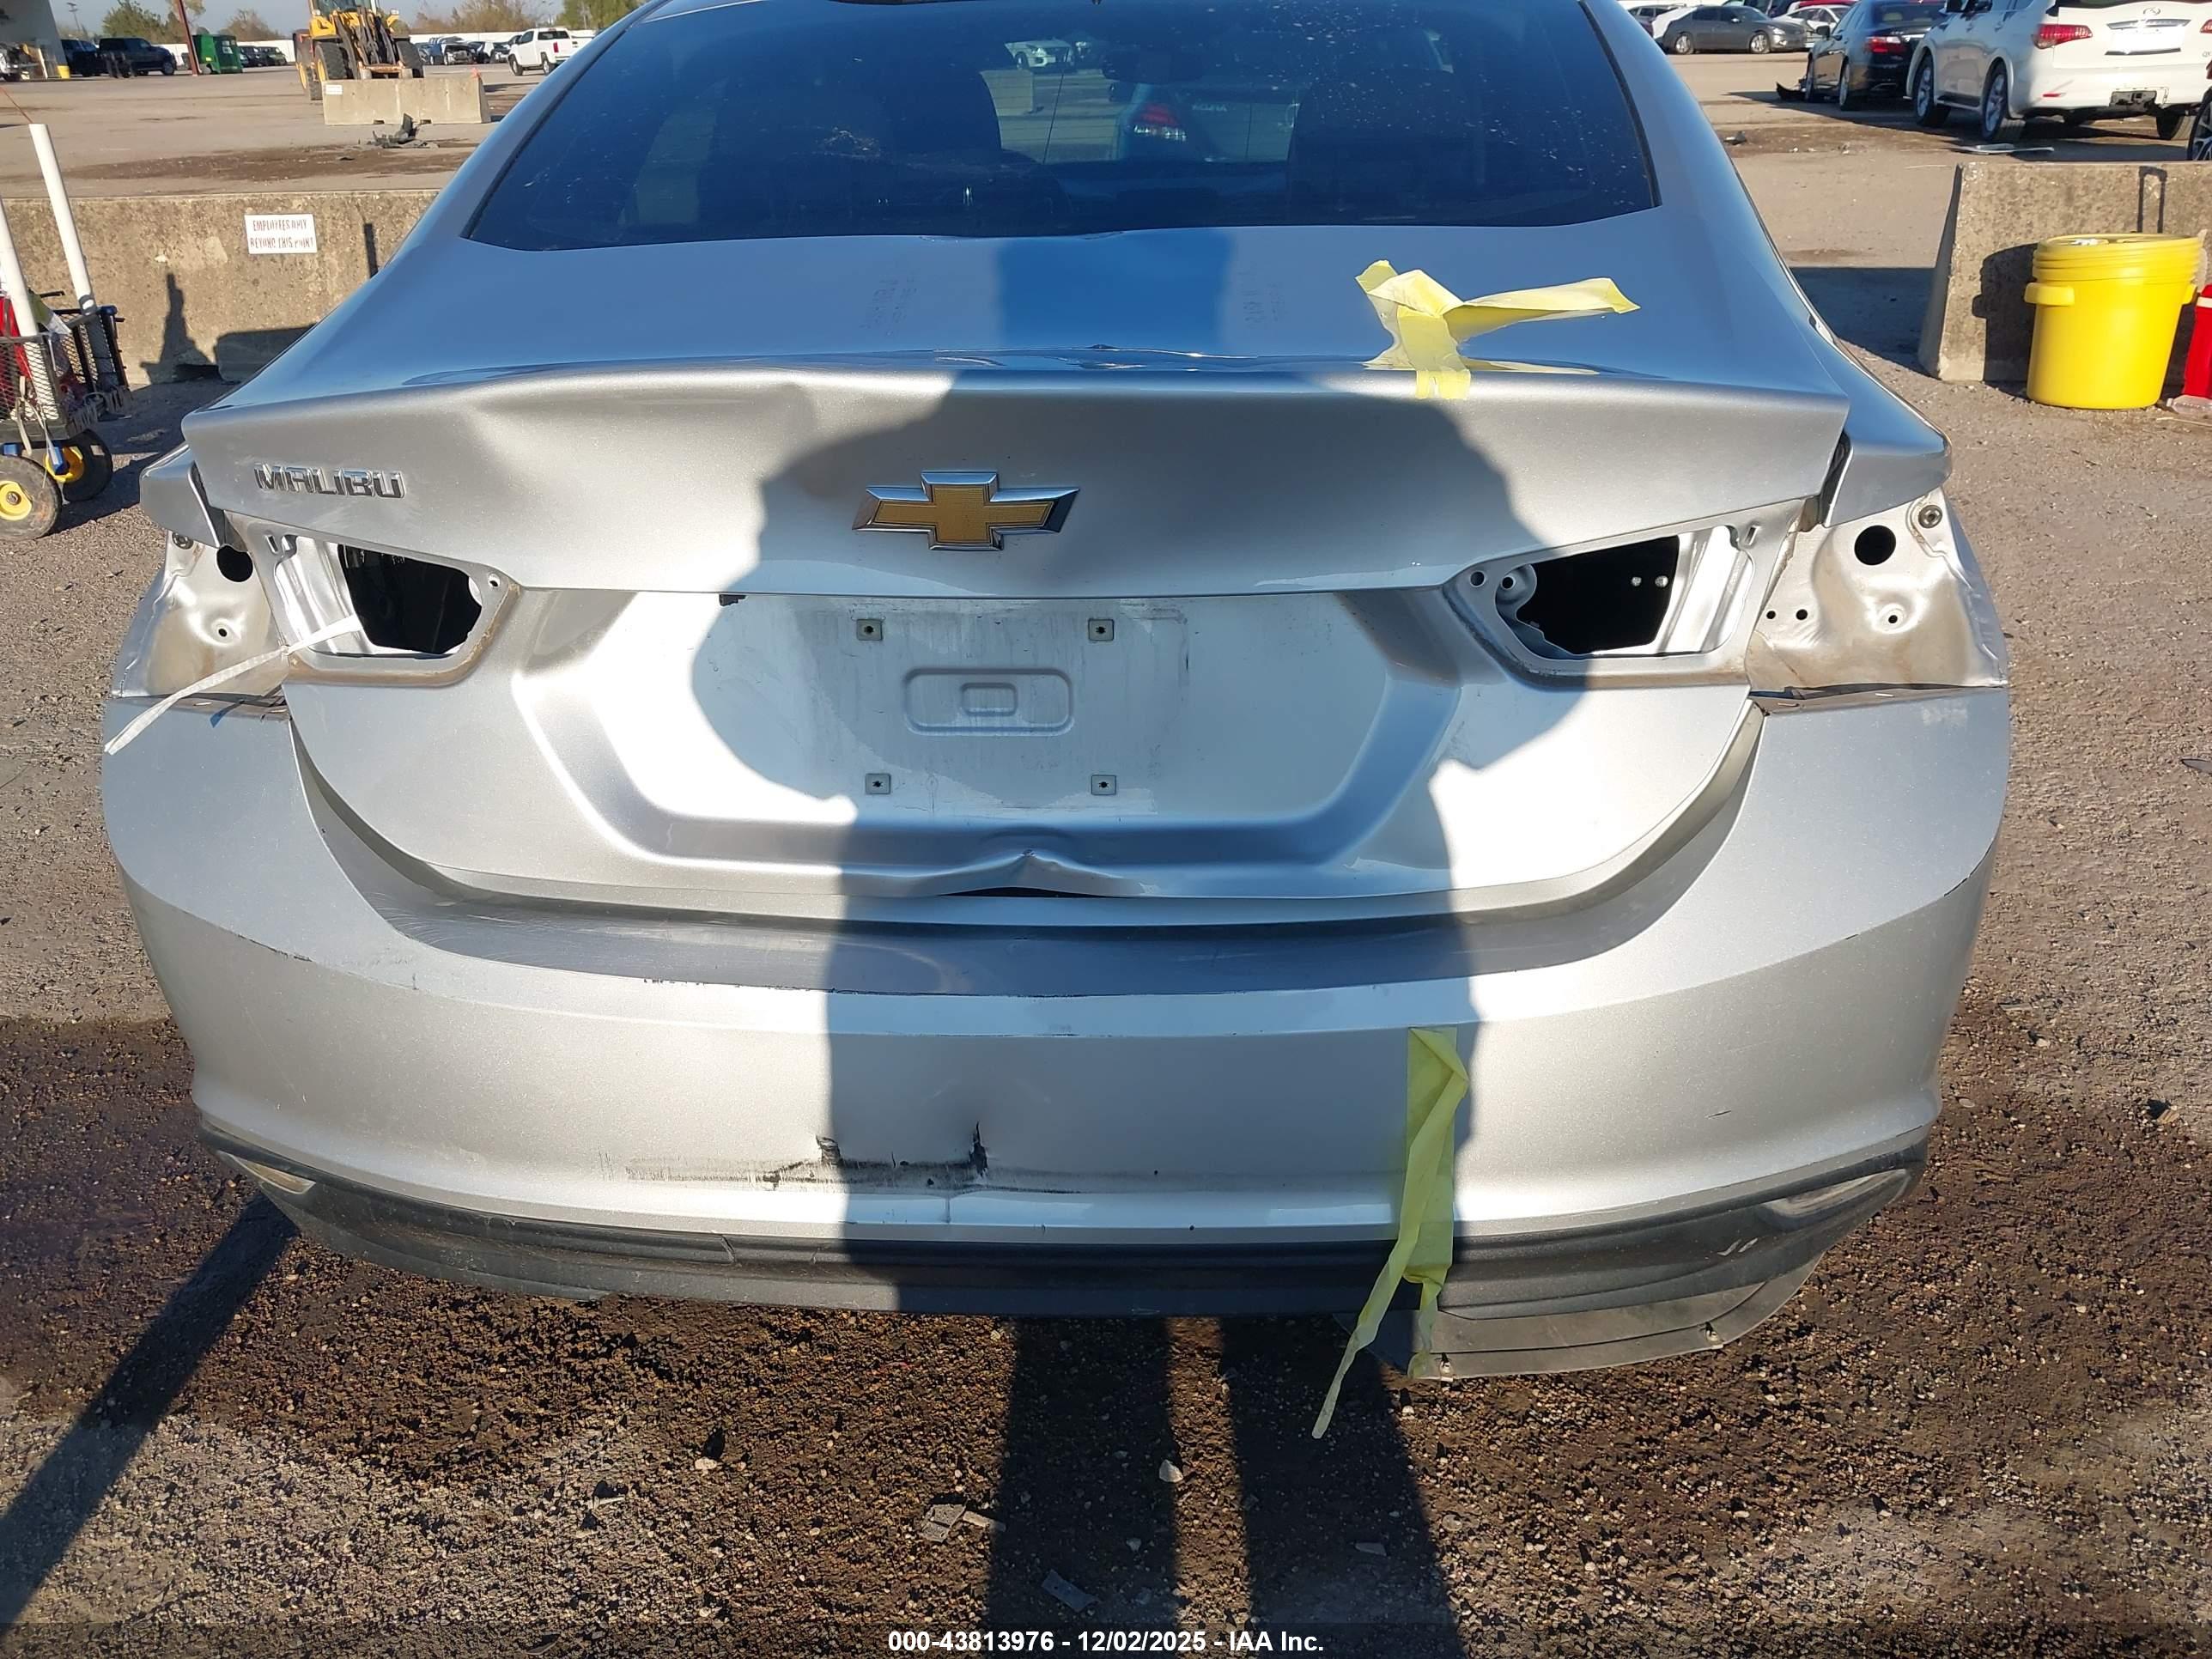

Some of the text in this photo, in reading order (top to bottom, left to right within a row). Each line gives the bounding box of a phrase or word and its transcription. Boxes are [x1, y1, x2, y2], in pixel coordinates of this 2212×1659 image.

[252, 218, 307, 232] EMPLOYEES ONLY
[250, 236, 313, 249] BEYOND THIS POINT
[254, 463, 405, 499] MALIBU
